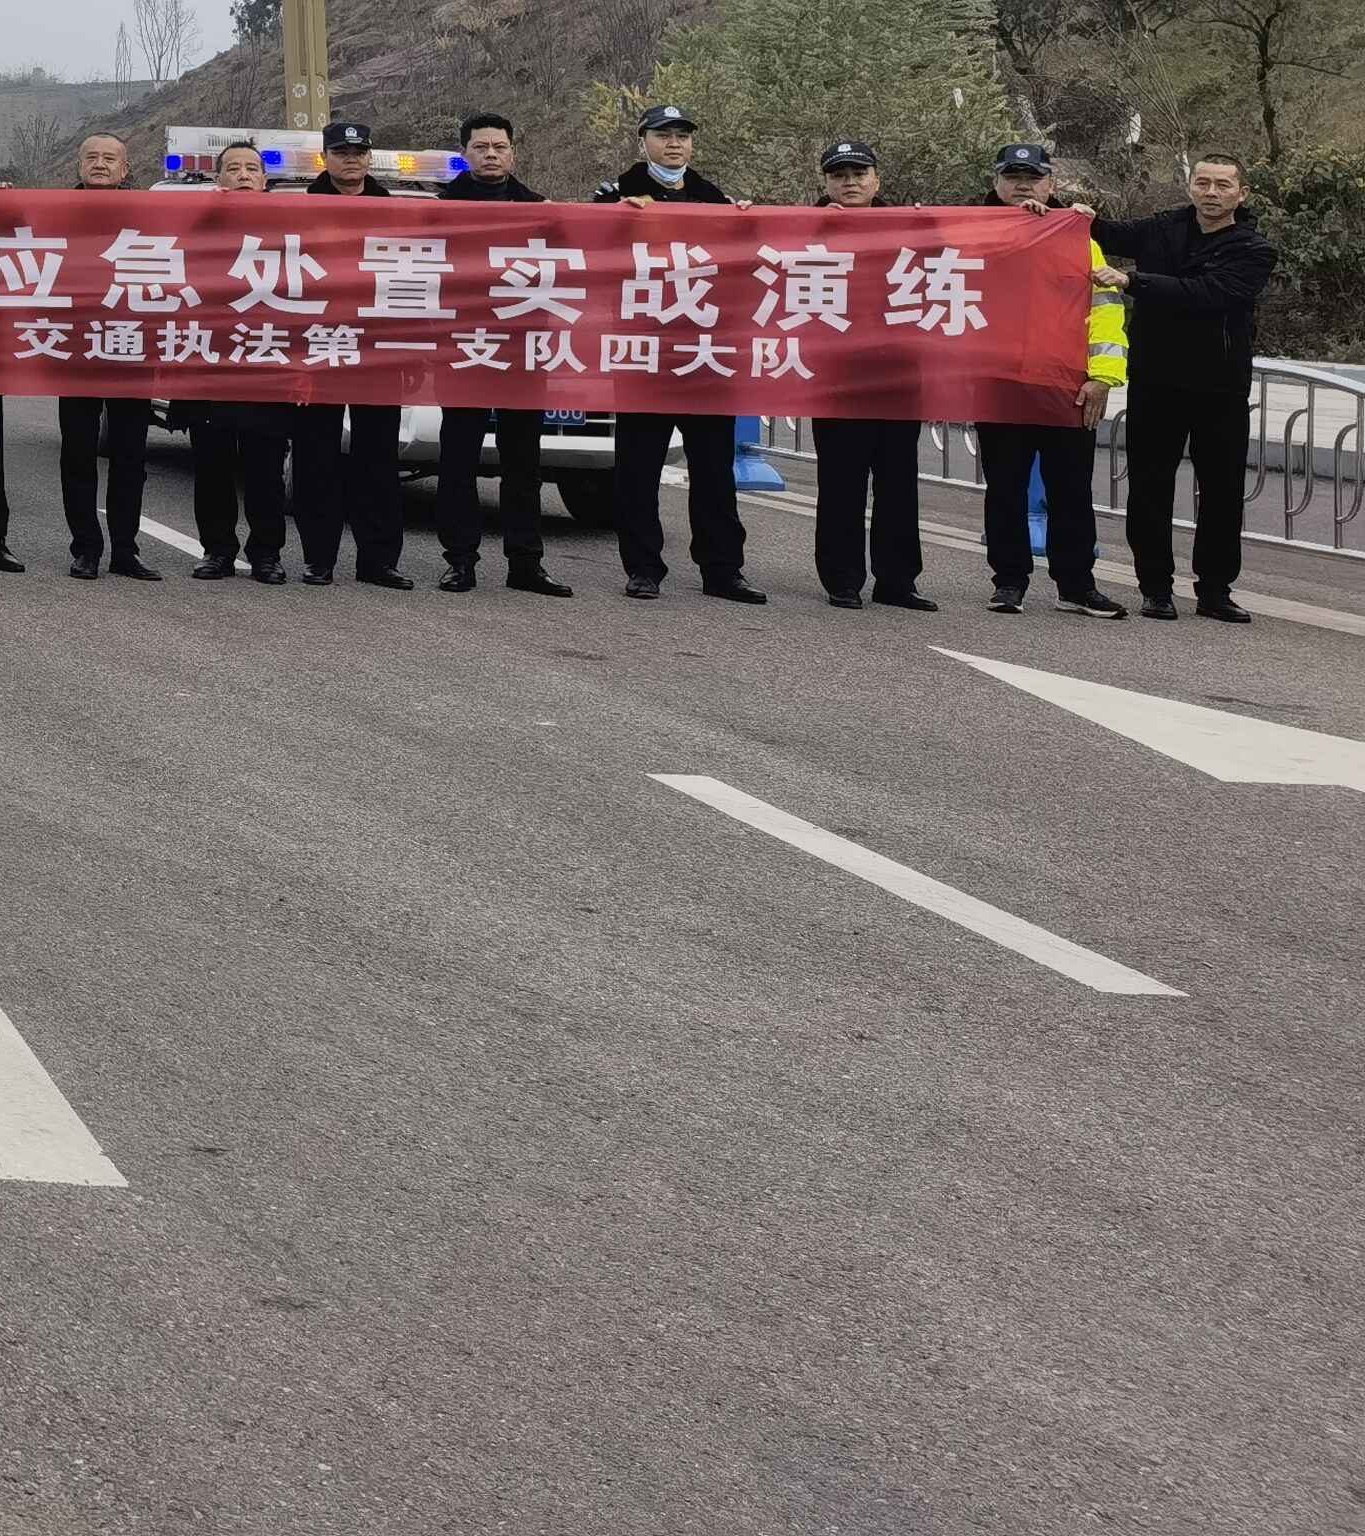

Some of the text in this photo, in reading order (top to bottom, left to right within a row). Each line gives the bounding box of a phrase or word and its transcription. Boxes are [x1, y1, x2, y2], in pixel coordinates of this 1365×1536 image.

[12, 317, 816, 381] 交通执法第一支队四大队
